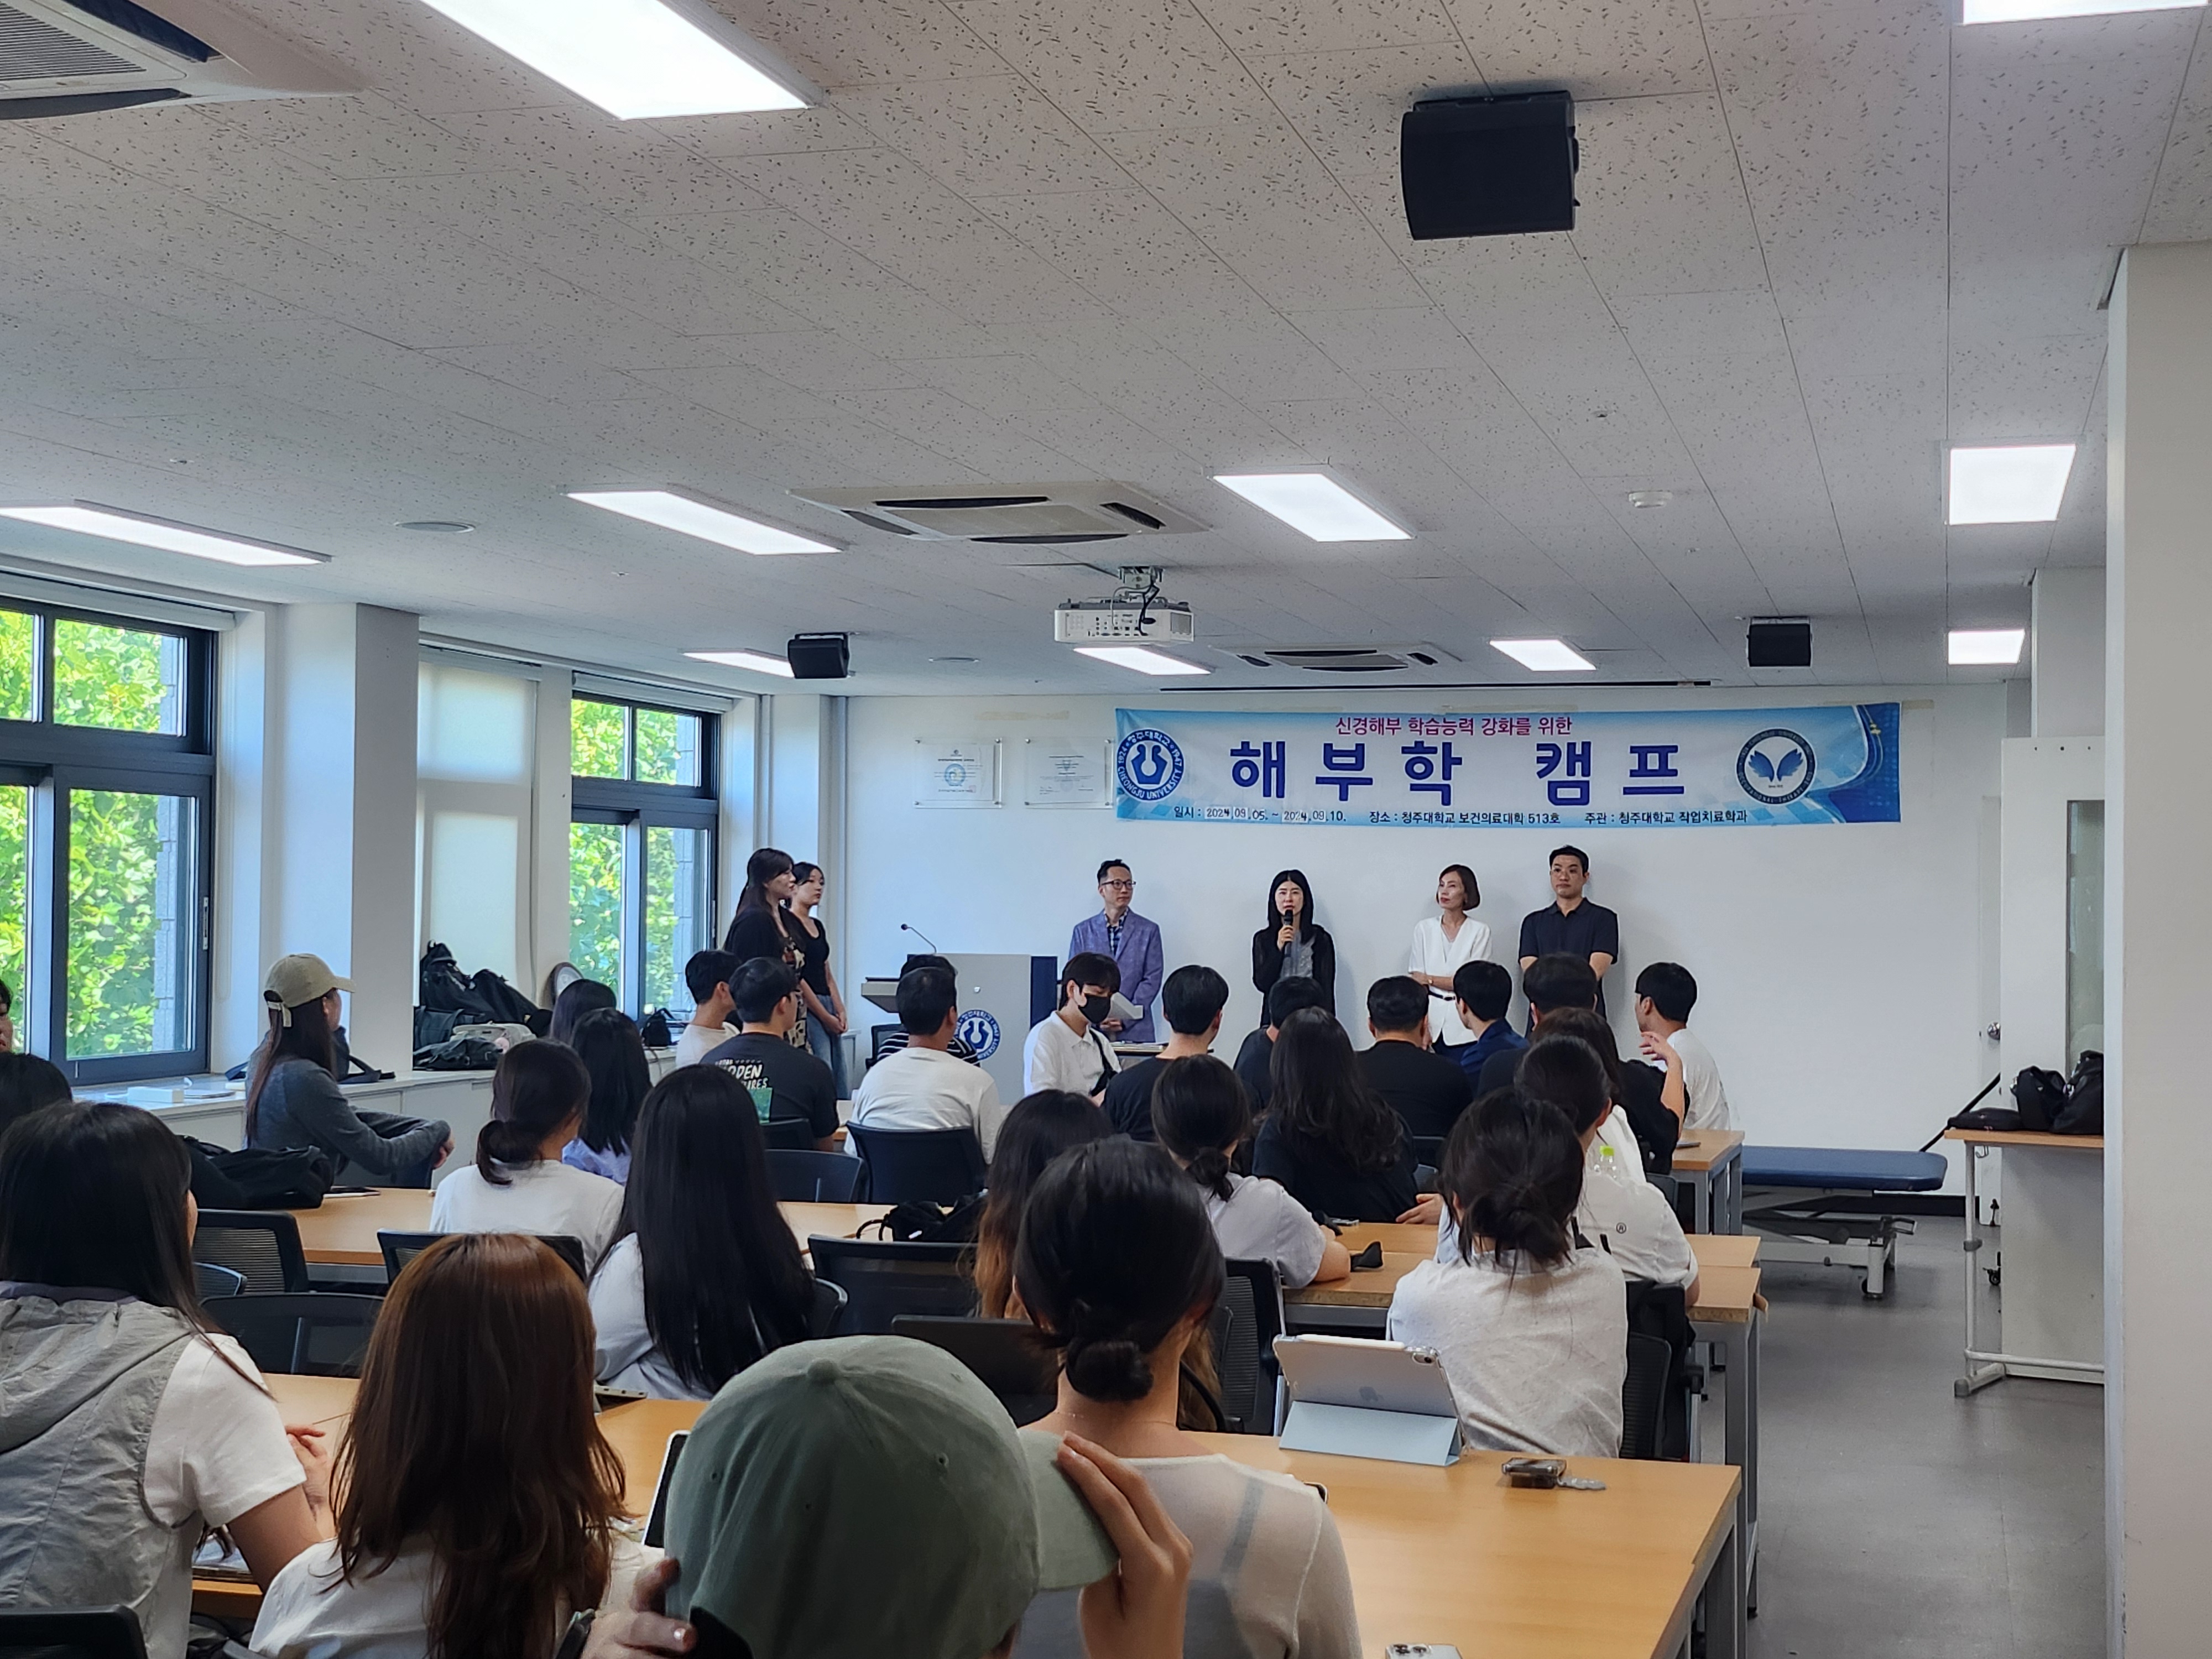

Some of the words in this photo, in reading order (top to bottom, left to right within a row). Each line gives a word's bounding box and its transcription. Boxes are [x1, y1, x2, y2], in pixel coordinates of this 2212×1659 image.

[1336, 717, 1402, 735] 신경해부
[1408, 717, 1474, 735] 학습능력
[1481, 717, 1531, 735] 강화를
[1538, 717, 1572, 735] 위한
[1127, 731, 1170, 747] 청주대학교
[1118, 746, 1128, 764] 1924
[1173, 806, 1194, 818] 일시
[1369, 811, 1391, 823] 장소
[1401, 812, 1455, 825] 청주대학교
[1459, 812, 1525, 825] 보건의료대학
[1528, 813, 1561, 823] 513호
[1584, 812, 1607, 825] 주관
[1619, 812, 1676, 824] 청주대학교
[1679, 810, 1748, 823] 작업치료학과
